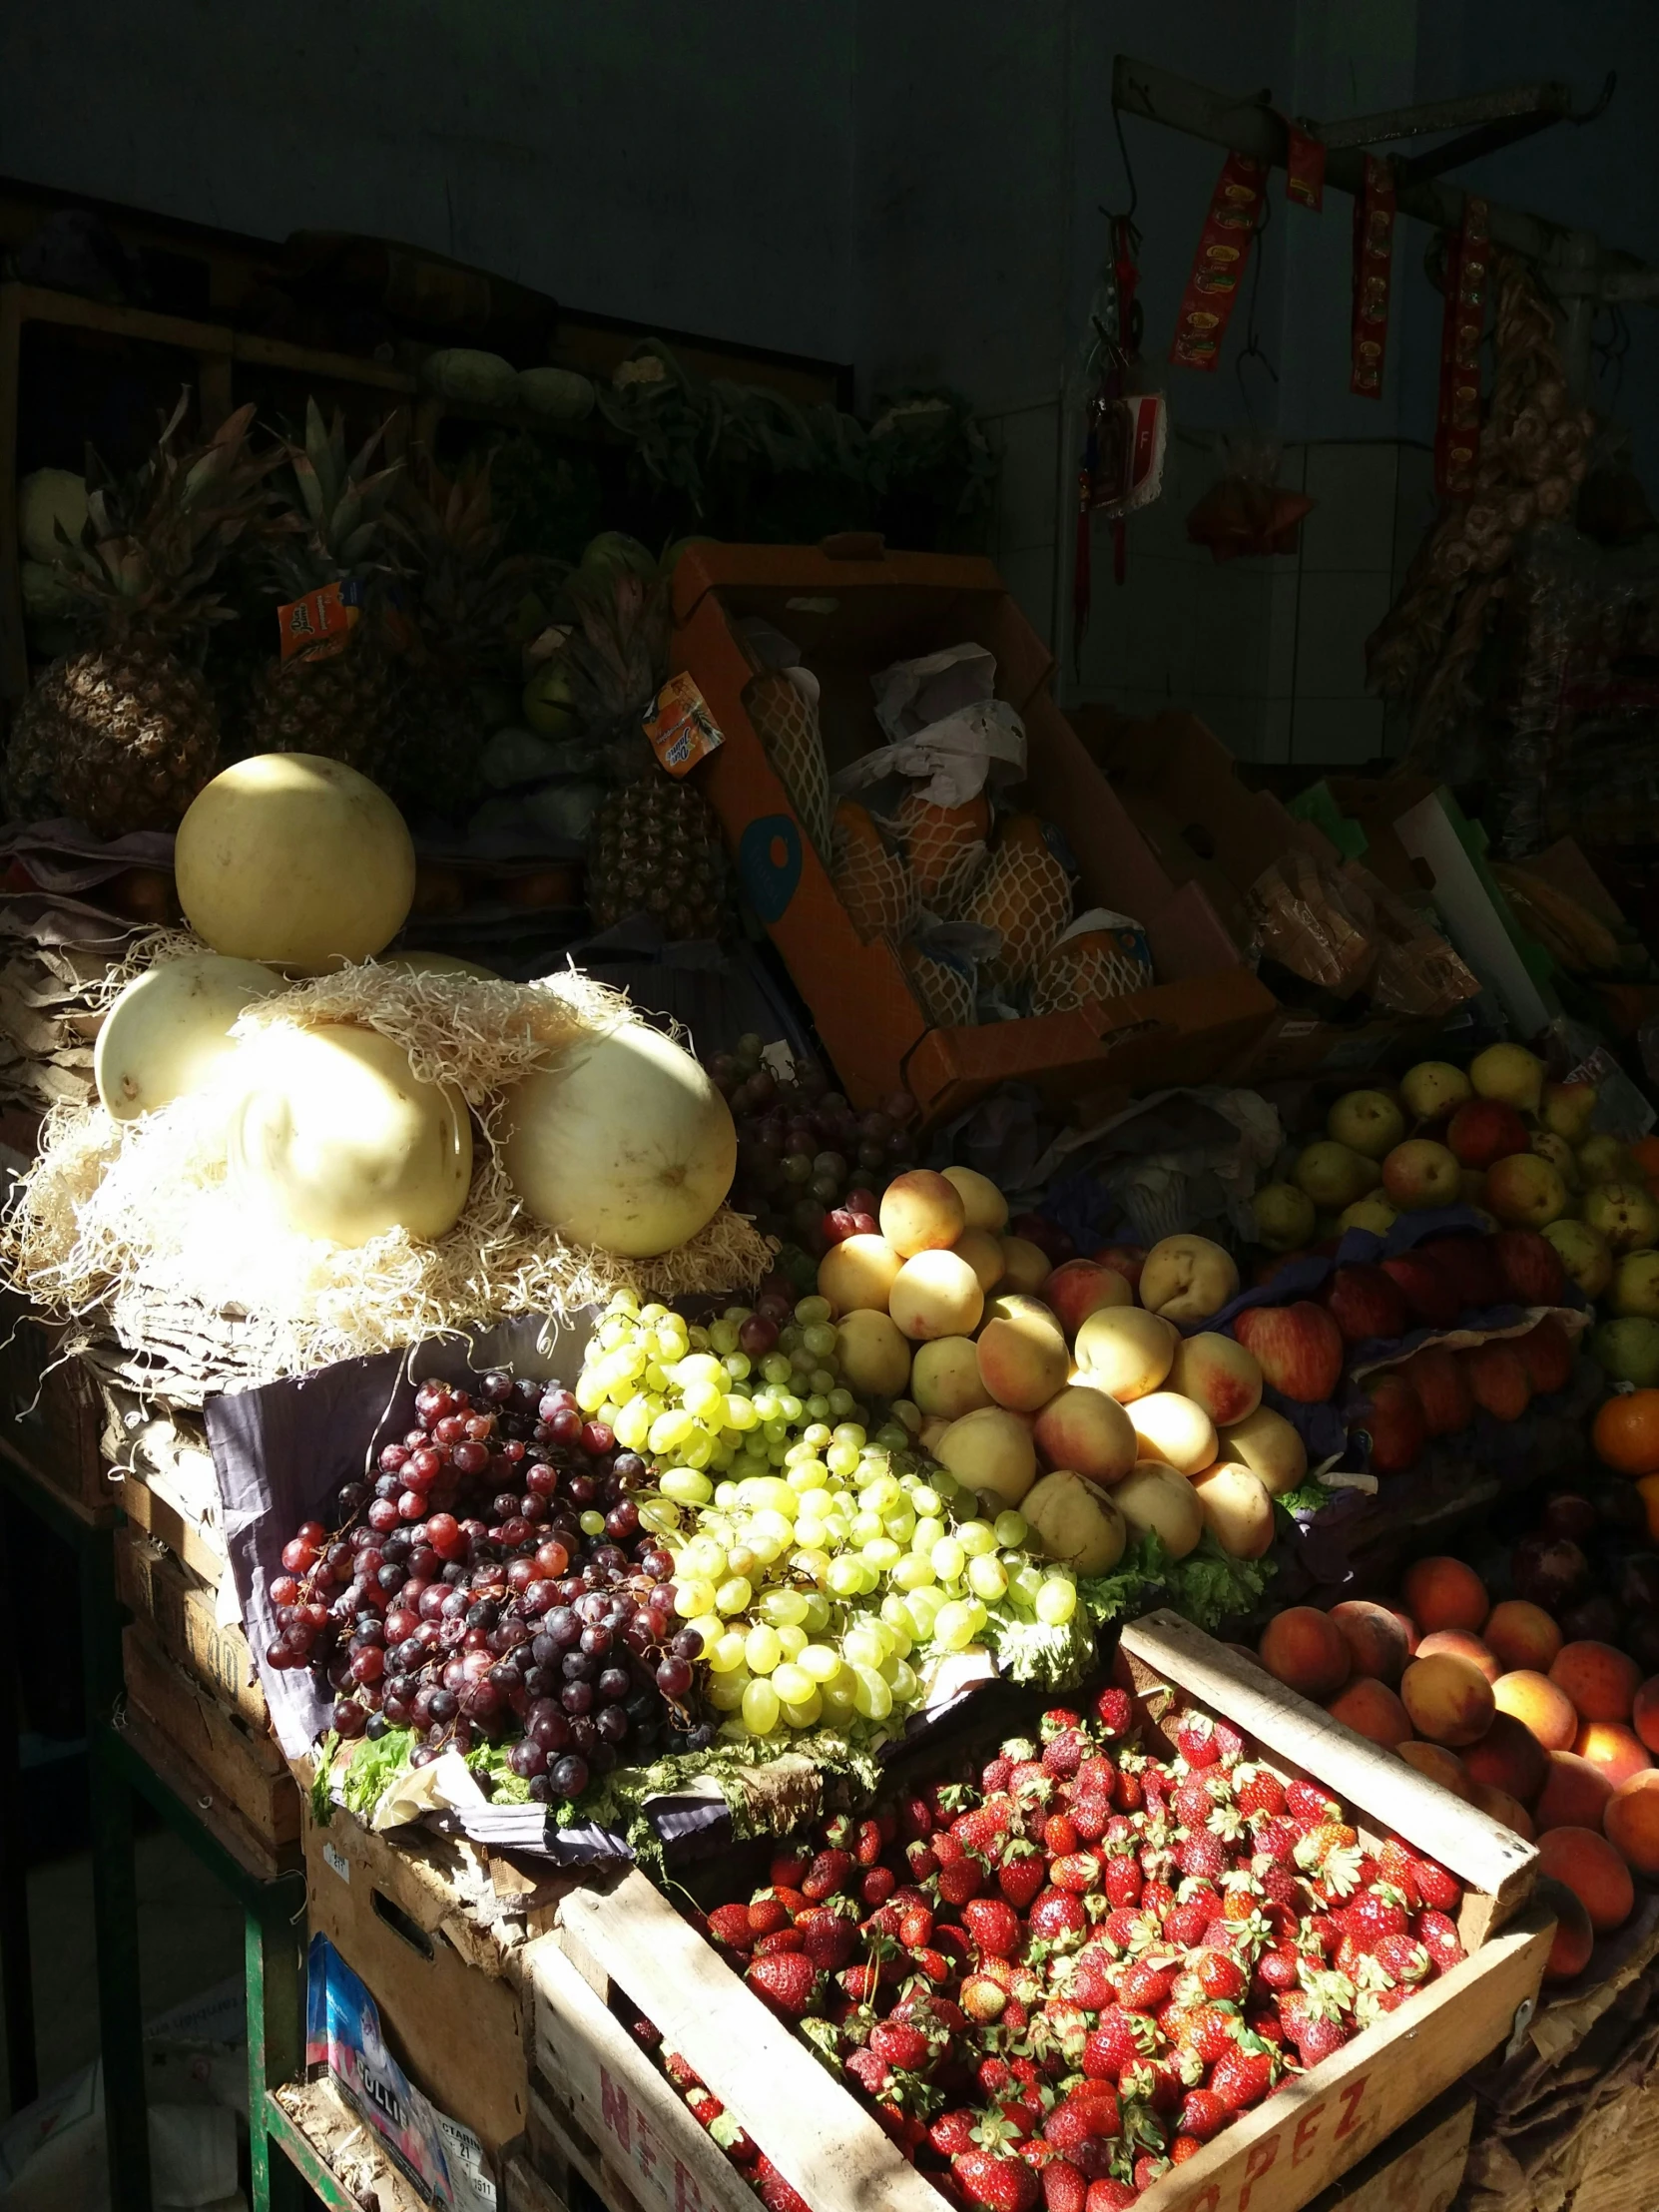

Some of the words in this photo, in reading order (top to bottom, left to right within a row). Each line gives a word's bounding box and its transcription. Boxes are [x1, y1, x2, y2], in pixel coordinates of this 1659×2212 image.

[1140, 430, 1150, 449] F
[290, 608, 301, 632] Don
[300, 603, 315, 635] Jaime
[666, 727, 692, 761] Jaime
[670, 745, 691, 767] Don
[356, 2059, 408, 2132] COLLIE
[459, 2143, 470, 2160] 21
